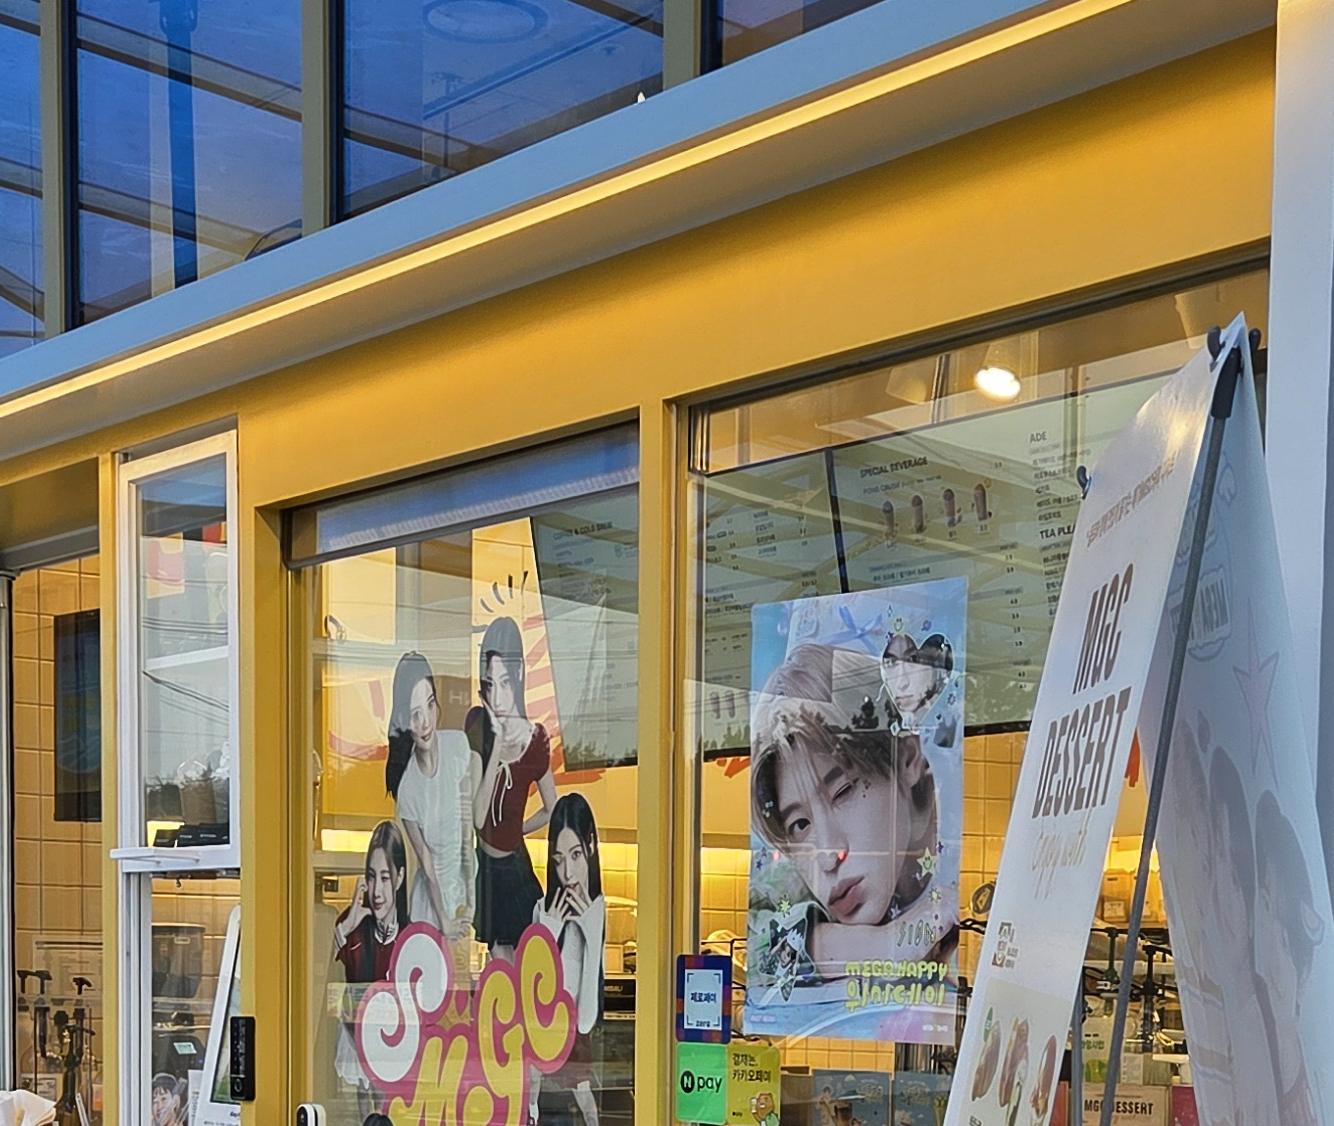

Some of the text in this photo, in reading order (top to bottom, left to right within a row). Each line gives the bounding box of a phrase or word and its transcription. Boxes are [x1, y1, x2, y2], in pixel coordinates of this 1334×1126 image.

[1029, 431, 1048, 443] ADE
[1039, 526, 1056, 540] TEA
[1072, 562, 1134, 695] MGC
[1031, 685, 1132, 820] DESSERT
[845, 959, 948, 981] MEGA HAPPY
[690, 991, 717, 1004] 제로페이
[732, 1068, 771, 1083] 카카오페이
[697, 1075, 723, 1093] pay
[1115, 1100, 1154, 1115] ESSERT
